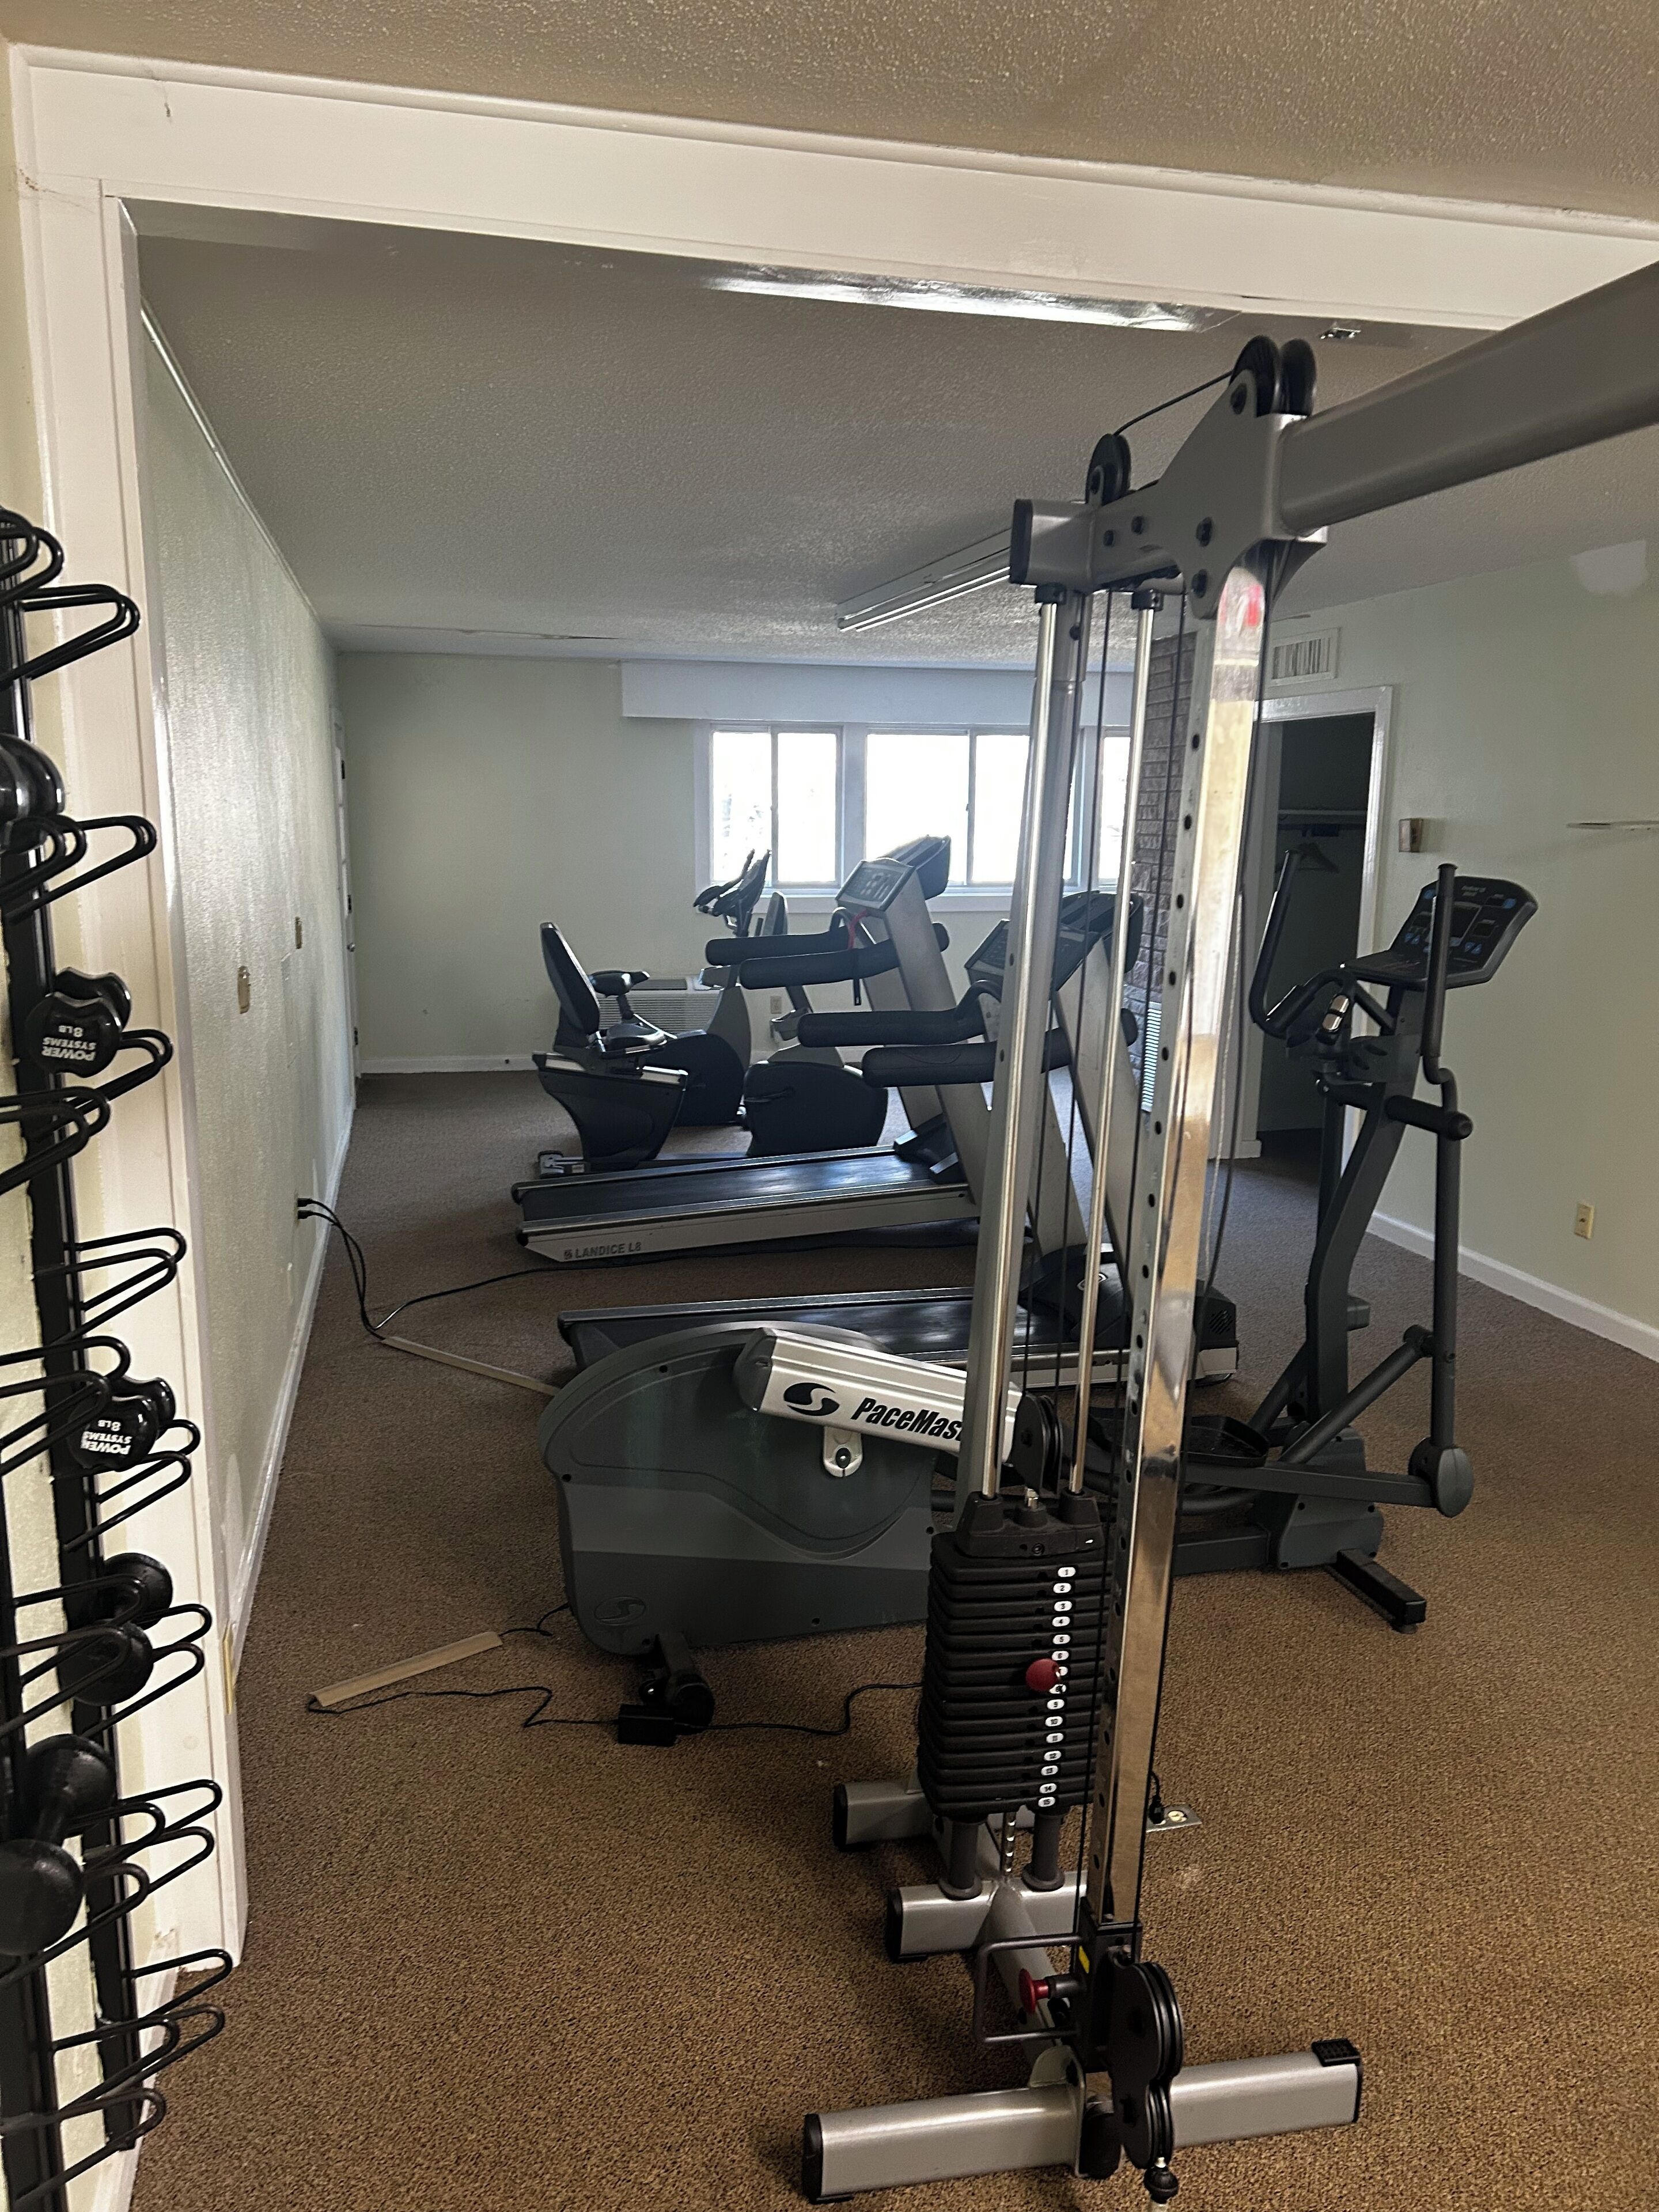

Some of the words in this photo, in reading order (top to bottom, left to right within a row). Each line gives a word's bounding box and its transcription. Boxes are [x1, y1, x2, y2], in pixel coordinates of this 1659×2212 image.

[42, 1037, 97, 1050] SYSTEMS
[41, 1046, 96, 1061] POWER
[575, 1243, 626, 1258] LANDICE
[851, 1397, 962, 1442] PaceMas
[81, 1431, 132, 1444] SYSTEMS
[80, 1440, 131, 1455] POWER
